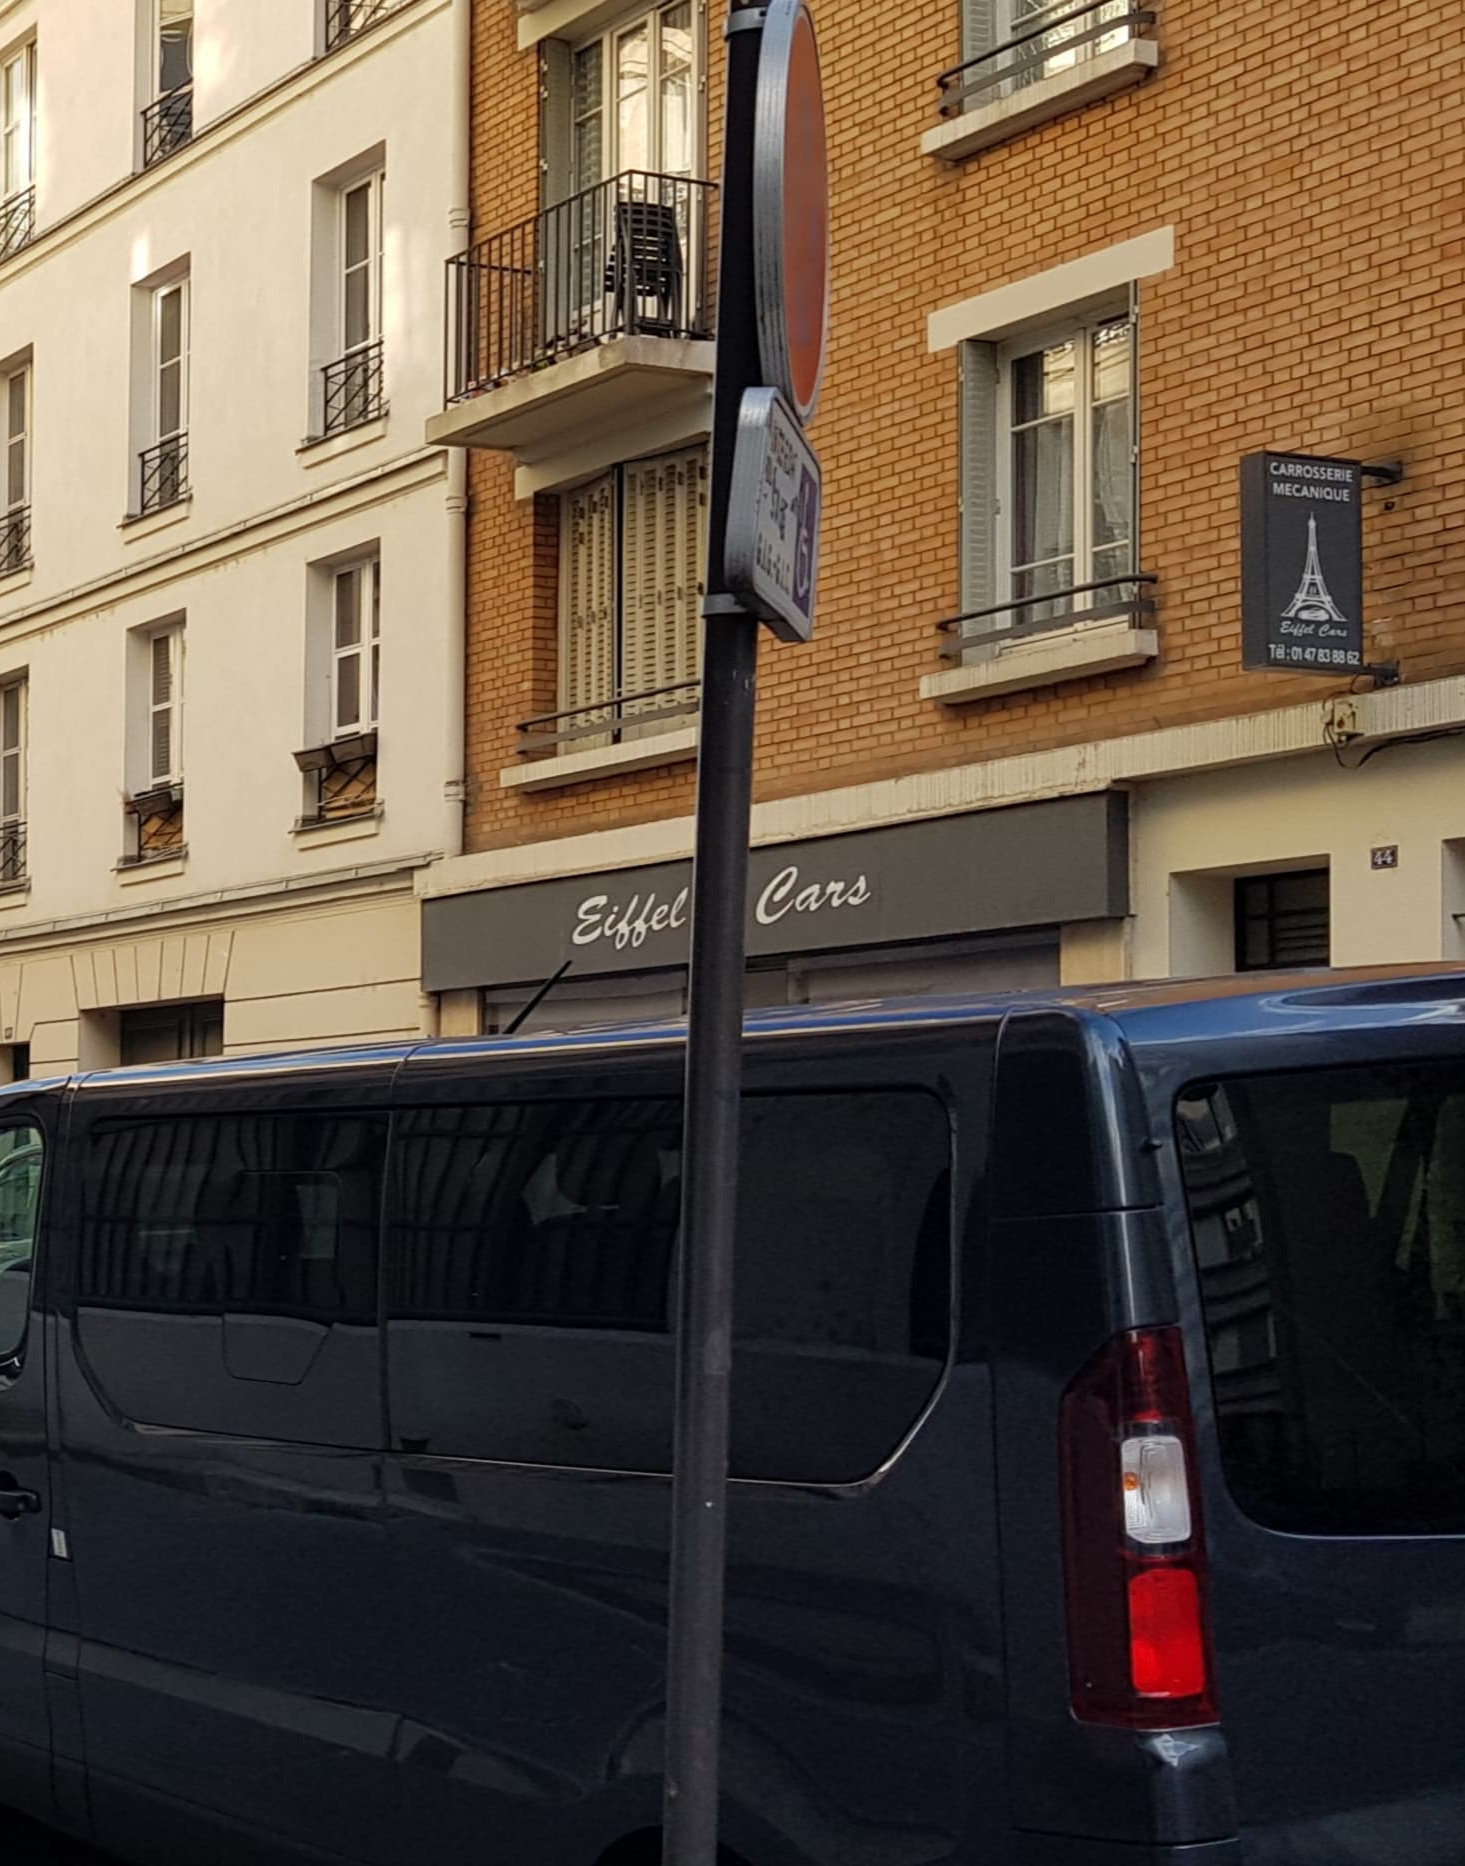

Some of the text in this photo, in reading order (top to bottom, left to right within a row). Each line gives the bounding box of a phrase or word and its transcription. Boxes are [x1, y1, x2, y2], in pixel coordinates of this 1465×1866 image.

[1270, 462, 1353, 482] CARROSSERIE
[1273, 482, 1350, 501] MECANIQUE
[1280, 620, 1348, 637] Eiffel Cars
[1304, 647, 1316, 661] 47
[1347, 651, 1360, 666] 62
[572, 866, 871, 950] Eiffel Cars
